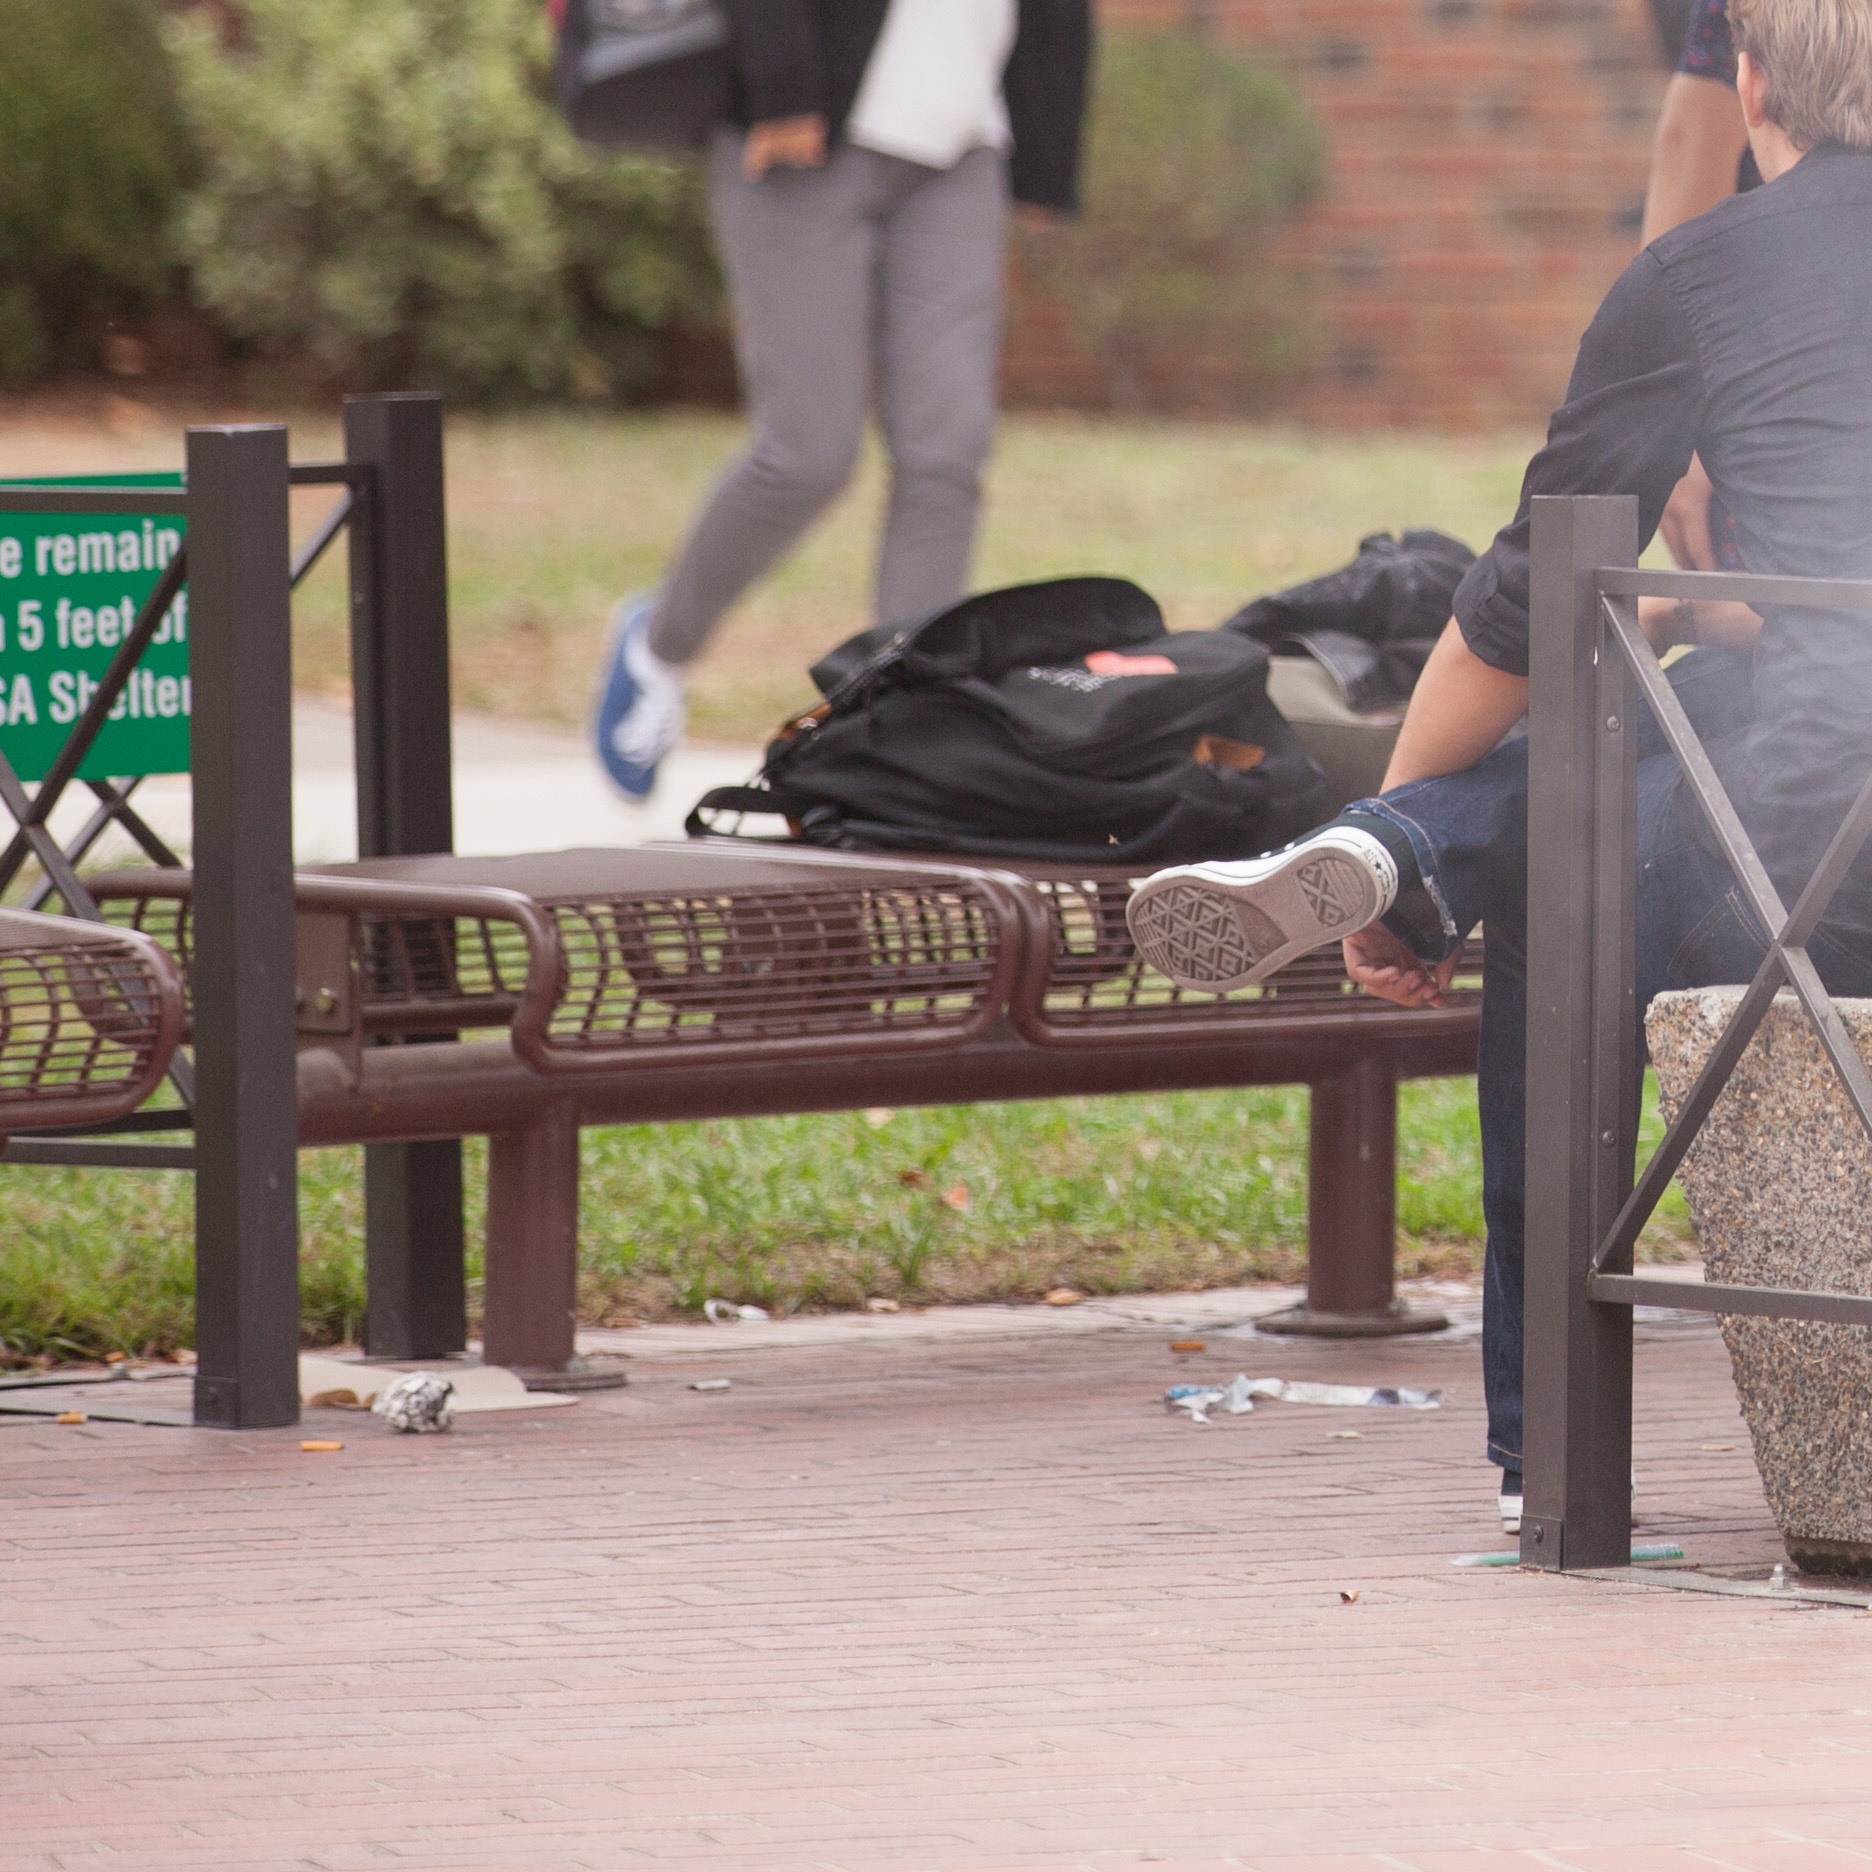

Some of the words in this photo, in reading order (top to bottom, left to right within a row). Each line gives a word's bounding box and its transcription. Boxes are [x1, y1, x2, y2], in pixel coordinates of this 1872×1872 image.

[35, 518, 181, 577] remain
[17, 599, 44, 652] 5
[55, 595, 135, 649] feet
